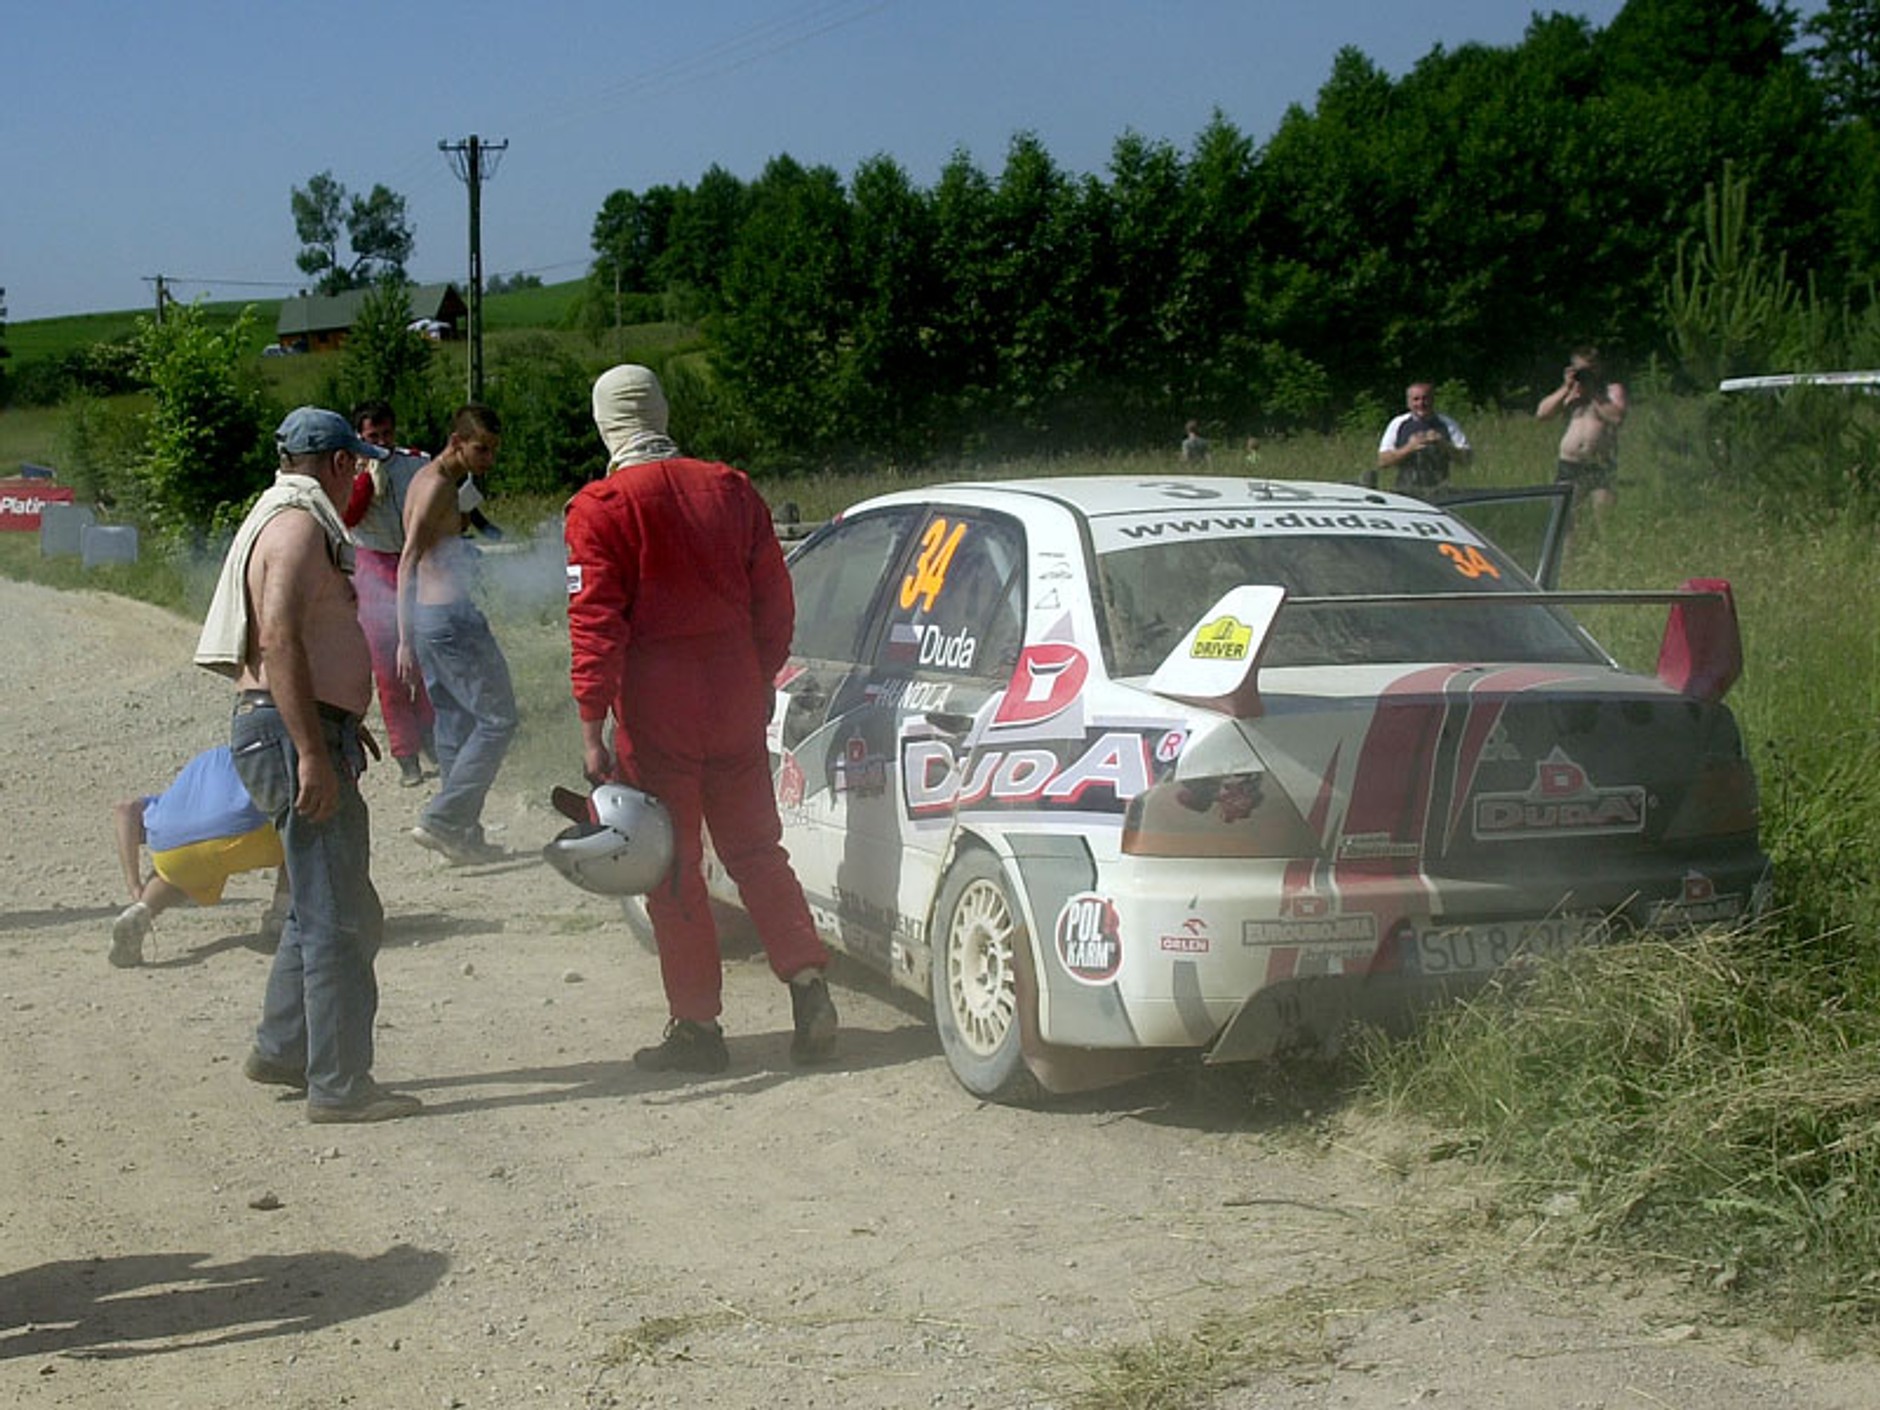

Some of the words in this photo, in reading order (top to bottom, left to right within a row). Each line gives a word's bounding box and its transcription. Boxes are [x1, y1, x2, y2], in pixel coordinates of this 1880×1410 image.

[1121, 511, 1454, 539] www.duda.pl
[900, 518, 967, 613] 34
[1438, 542, 1500, 580] 34
[919, 624, 976, 669] Duda
[1194, 641, 1244, 657] DRIVER
[1065, 901, 1102, 942] POL
[1066, 941, 1110, 969] KARM
[1161, 936, 1209, 951] ORLEN
